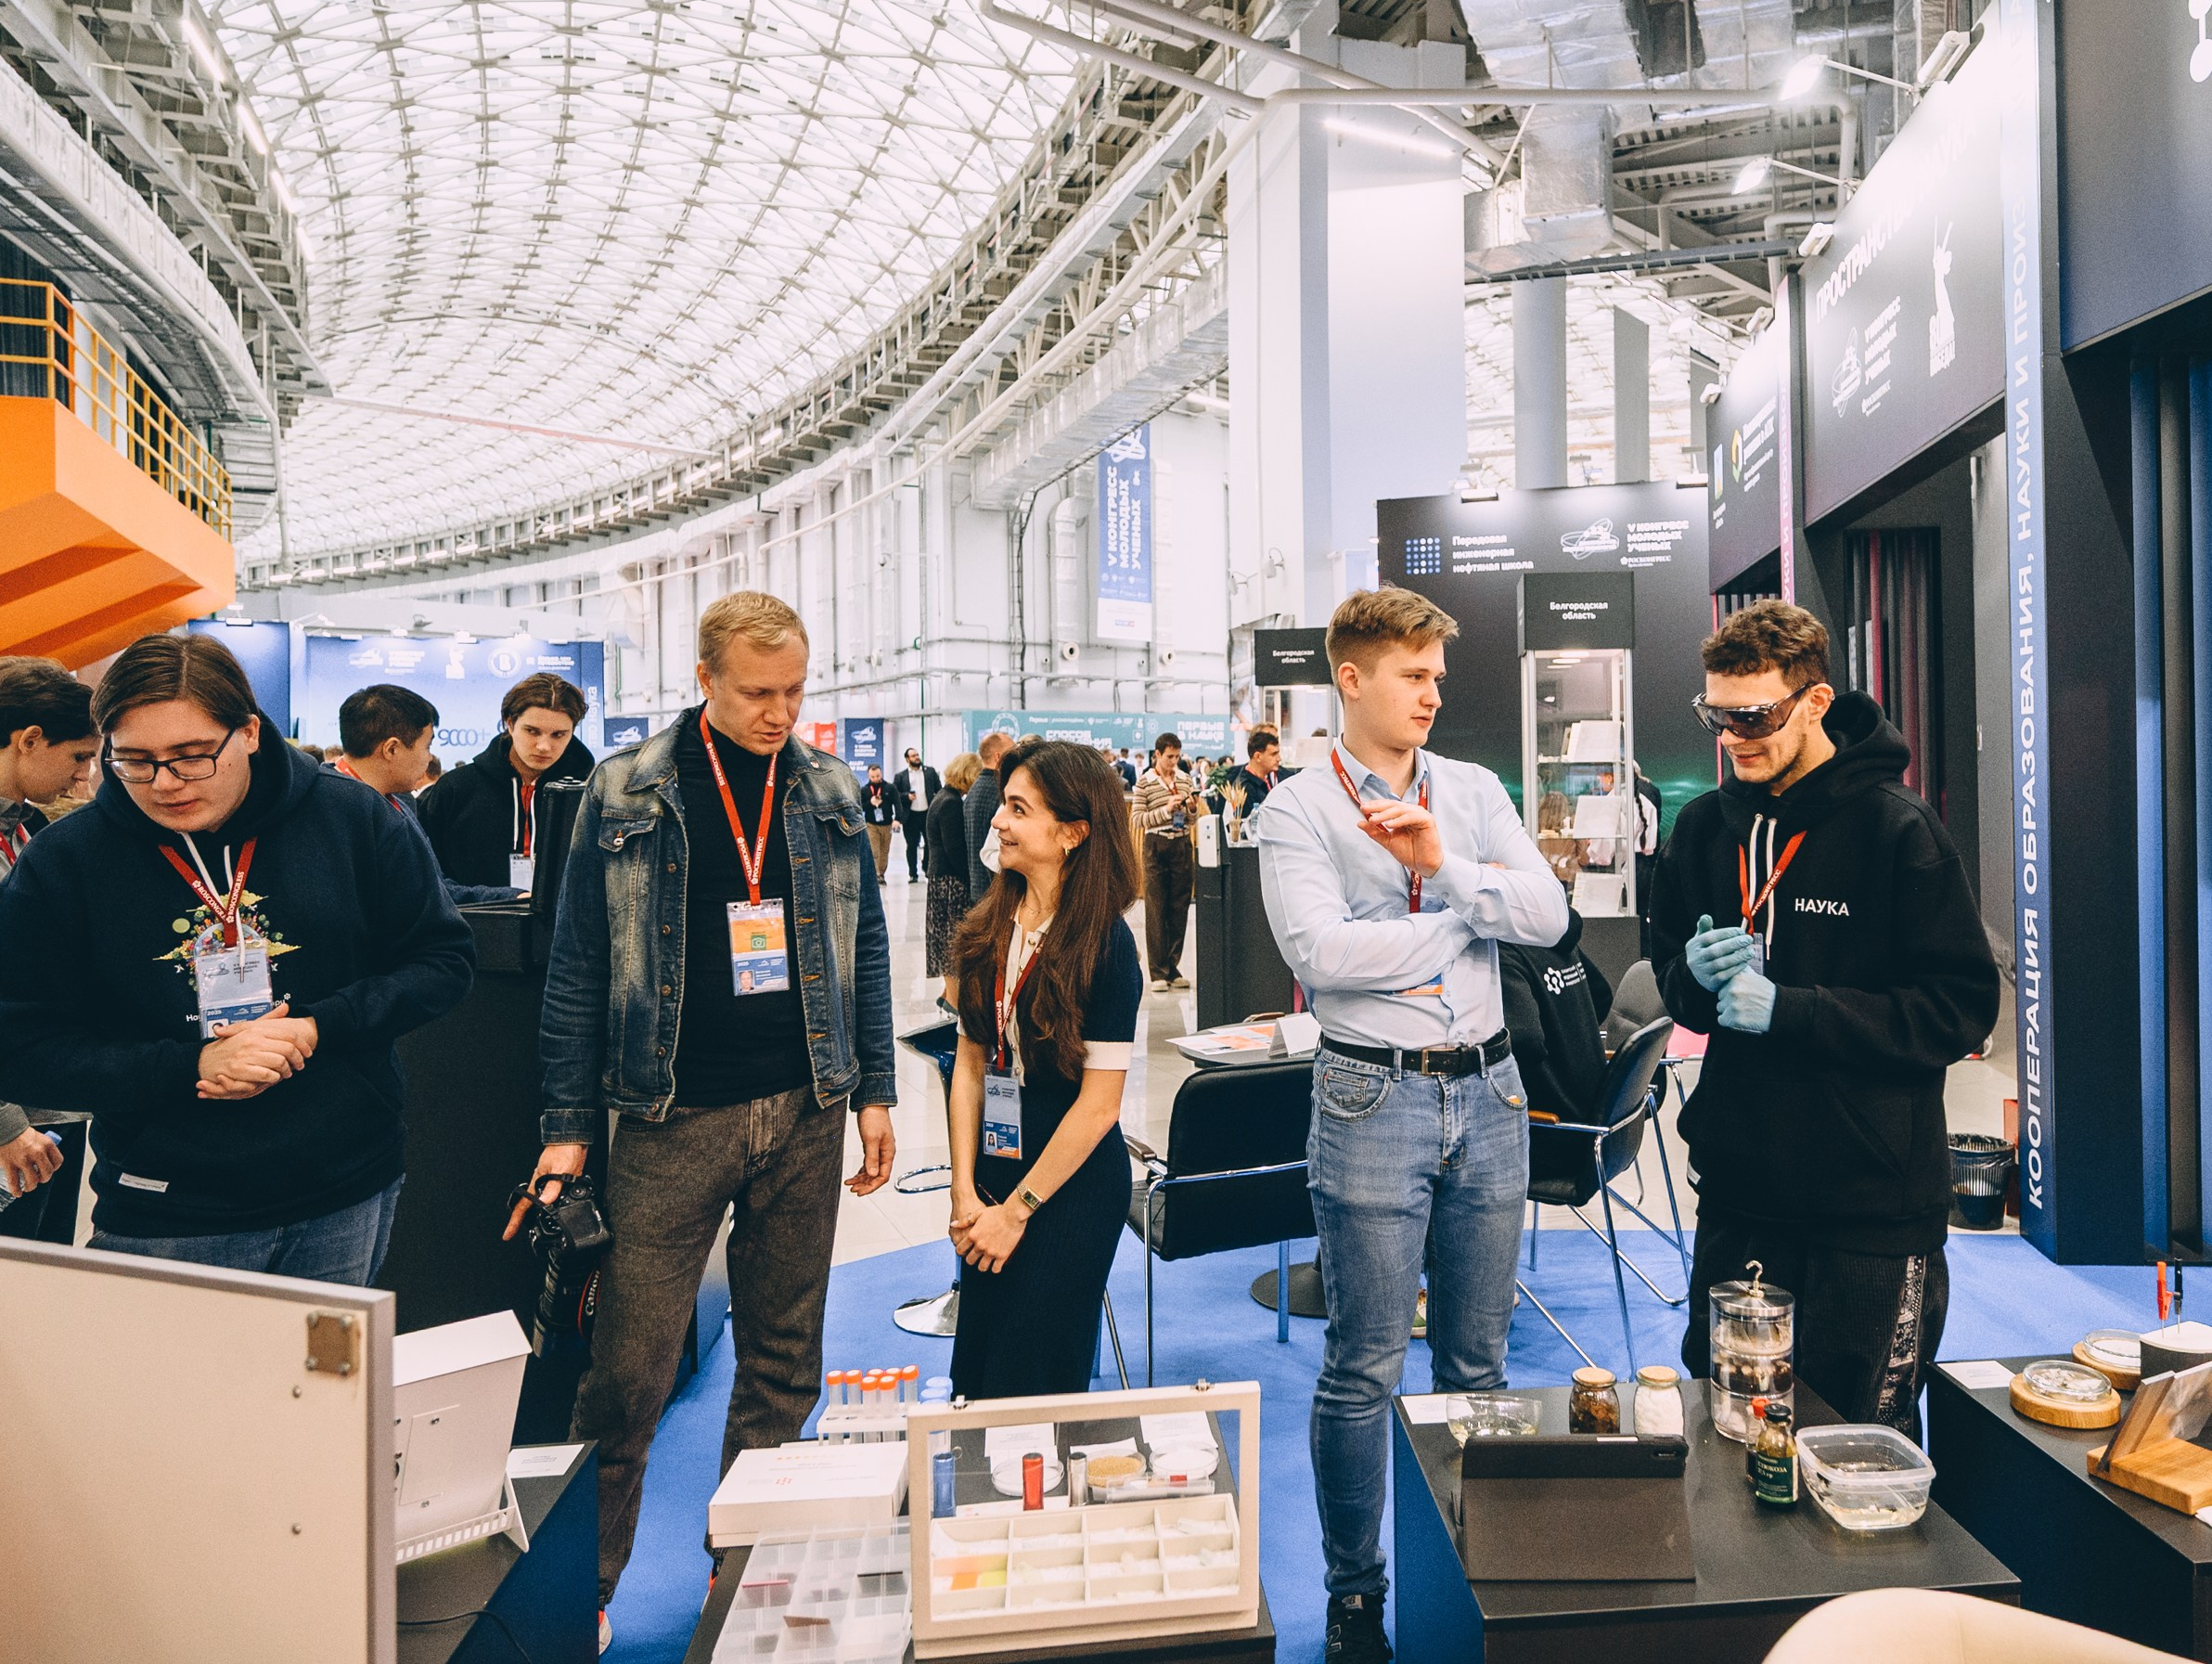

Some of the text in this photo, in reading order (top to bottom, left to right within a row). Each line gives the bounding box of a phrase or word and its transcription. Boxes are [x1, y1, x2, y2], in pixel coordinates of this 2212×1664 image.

[2014, 355, 2029, 388] И
[2015, 397, 2032, 542] НАУКИ
[1107, 466, 1118, 551] КОНГРЕСС
[1119, 479, 1130, 569] МОЛОДЫХ
[1131, 498, 1141, 570] УЧЕНЫХ
[1452, 535, 1508, 547] Передовая
[1627, 520, 1690, 533] V КОНГРЕСС
[1627, 531, 1683, 543] МОЛОДЫХ
[1452, 548, 1515, 560] инженерная
[1627, 541, 1672, 552] УЧЕНЫХ
[1452, 560, 1535, 574] нефтяная школа
[1550, 601, 1608, 613] Белгородская
[1562, 611, 1597, 621] область
[2018, 552, 2038, 895] ОБРАЗОВАНИЯ,
[198, 885, 226, 922] ROSCONGR
[228, 871, 245, 917] ROSCONGRESS
[1794, 897, 1850, 917] НАУКА
[2023, 909, 2043, 1209] КООПЕРАЦИЯ
[585, 1270, 600, 1316] Canon
